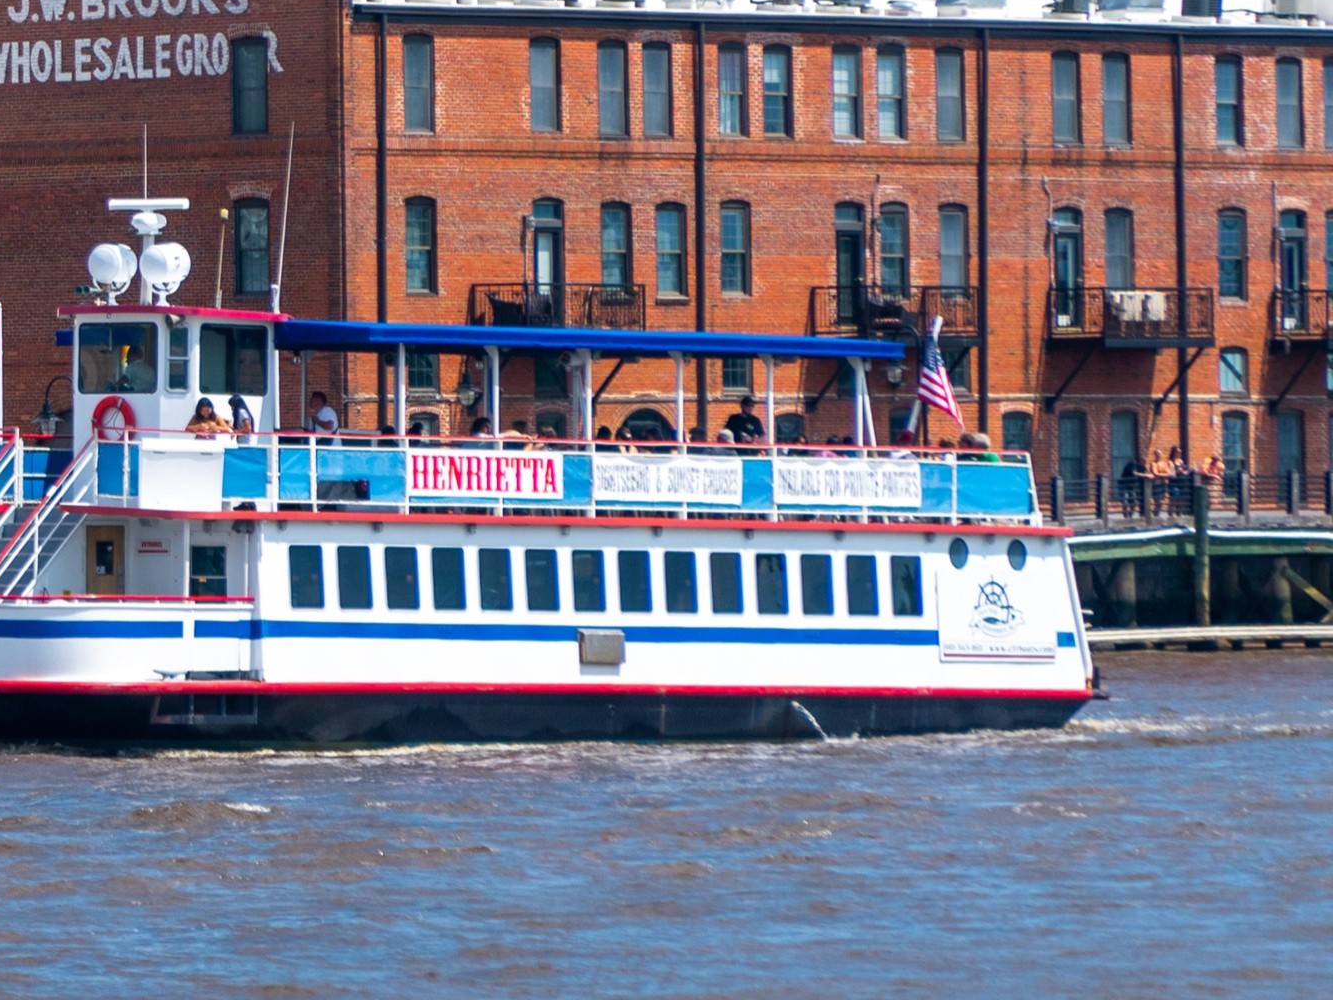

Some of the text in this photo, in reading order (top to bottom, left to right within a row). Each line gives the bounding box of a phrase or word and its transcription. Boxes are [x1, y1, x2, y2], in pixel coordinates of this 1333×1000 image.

[175, 30, 283, 77] GROR
[411, 454, 559, 494] HENRIETTA
[778, 468, 820, 497] AVAILABLE
[824, 469, 842, 497] FOR
